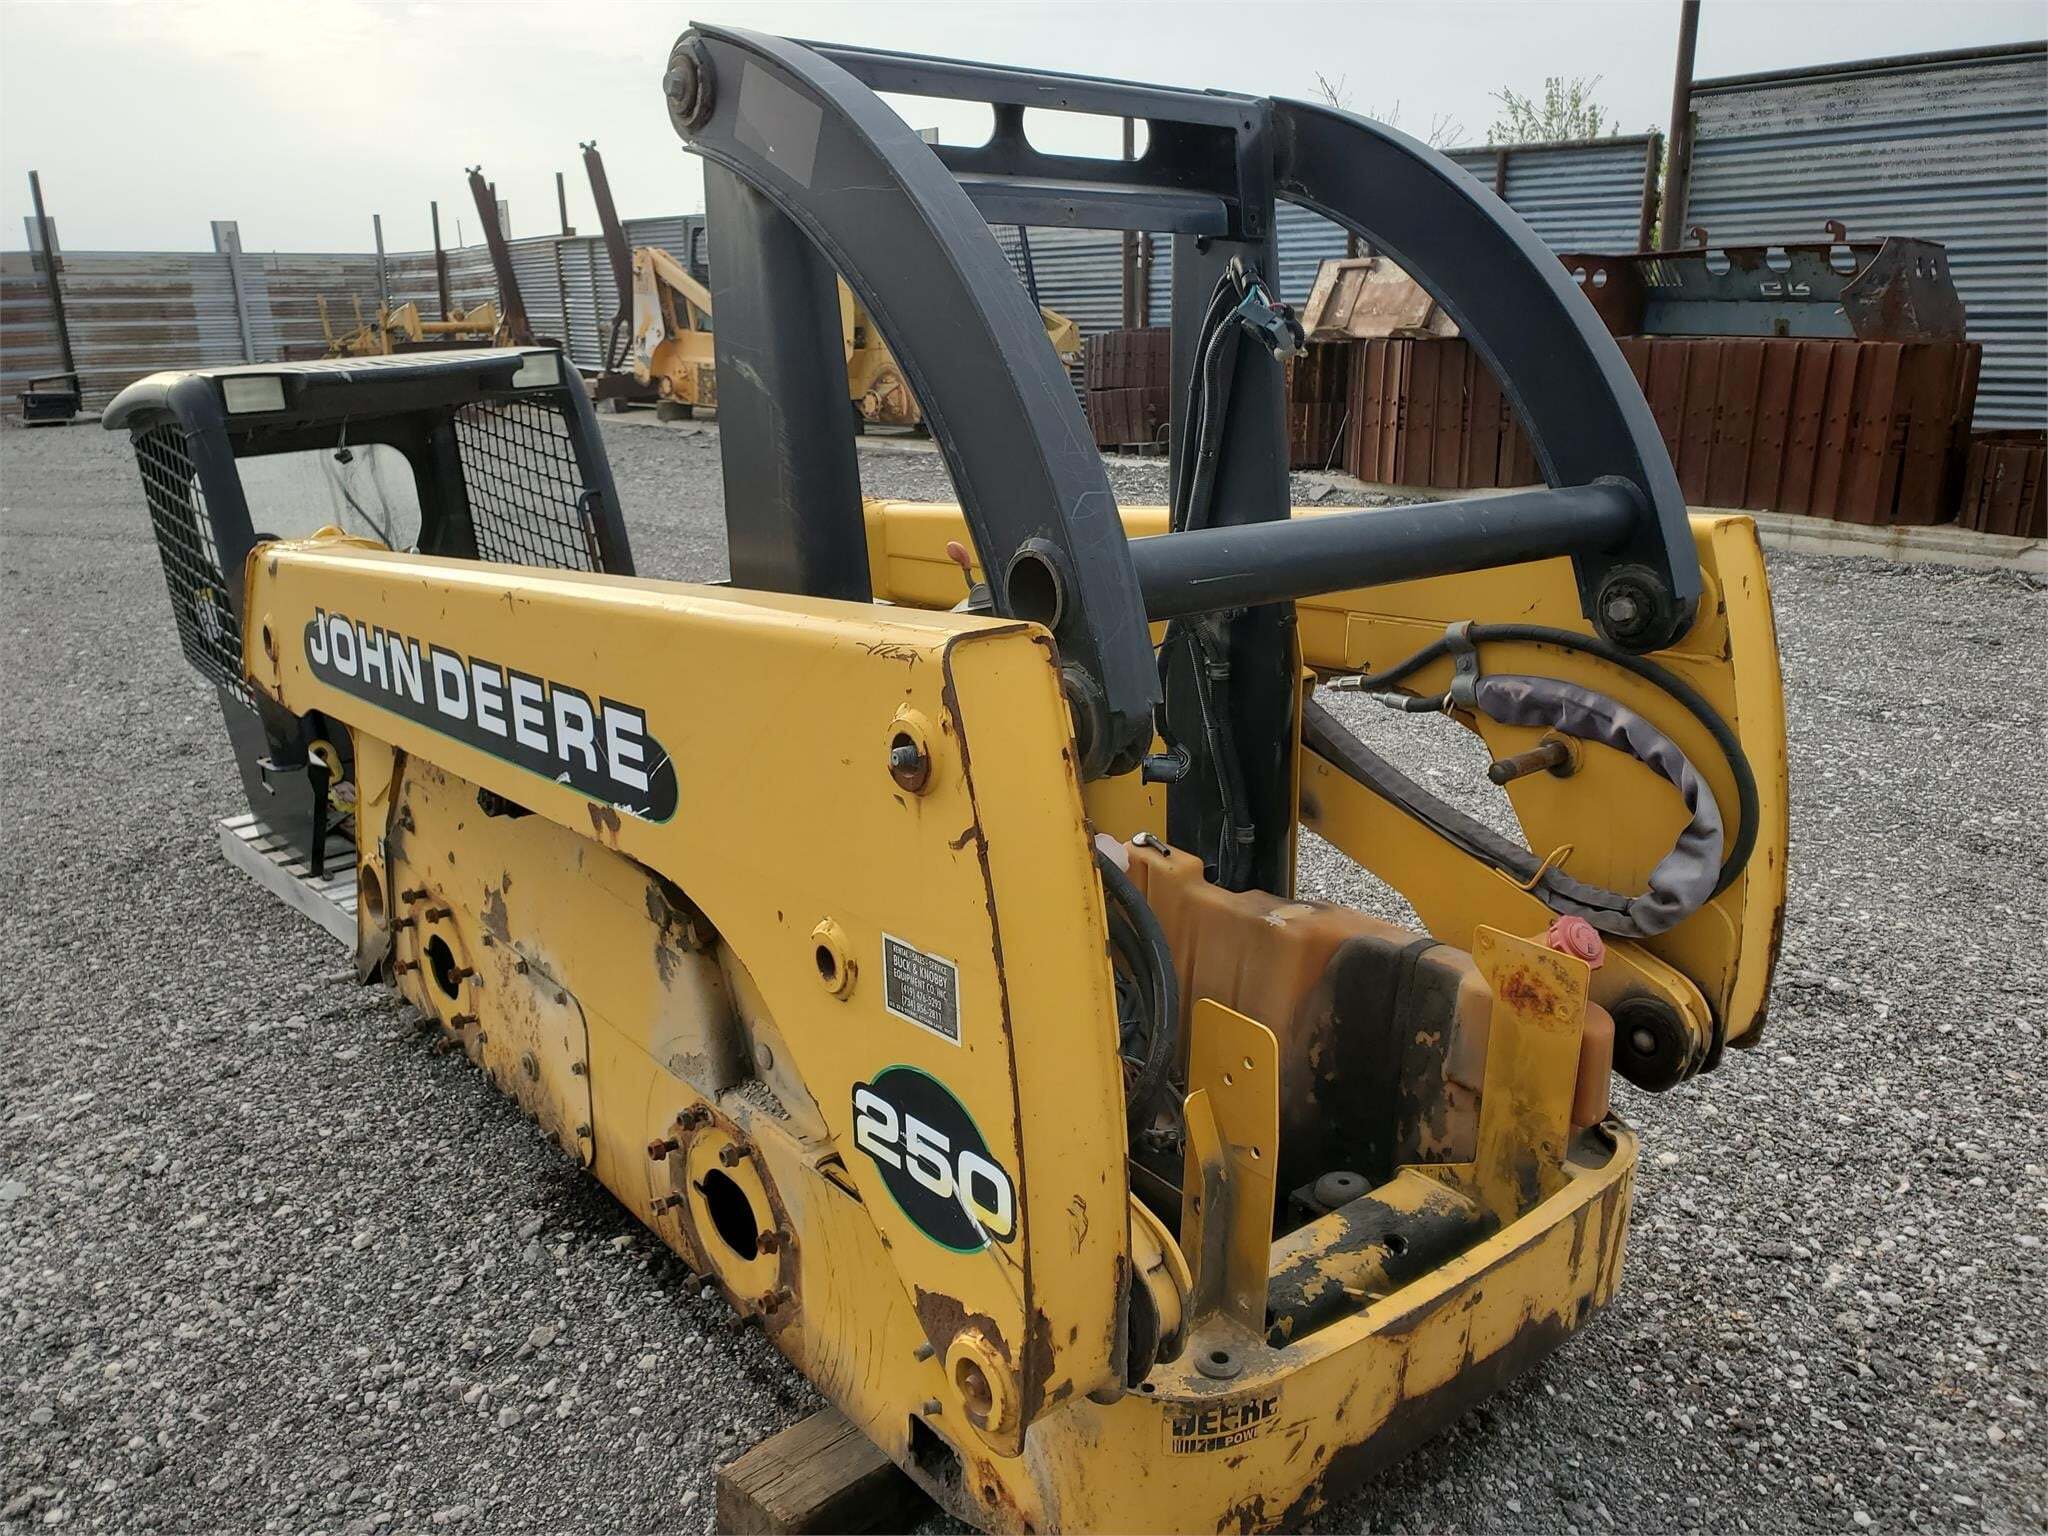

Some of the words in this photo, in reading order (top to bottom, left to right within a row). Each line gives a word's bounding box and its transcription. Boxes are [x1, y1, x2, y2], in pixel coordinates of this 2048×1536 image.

[308, 611, 426, 705] JOHN
[431, 649, 649, 793] DEERE
[893, 955, 912, 973] BUCK
[912, 963, 919, 976] &
[919, 966, 948, 988] KNOBBY
[893, 968, 925, 990] EQUIPMENT
[928, 960, 948, 976] SERVICE
[856, 1088, 1012, 1236] 250
